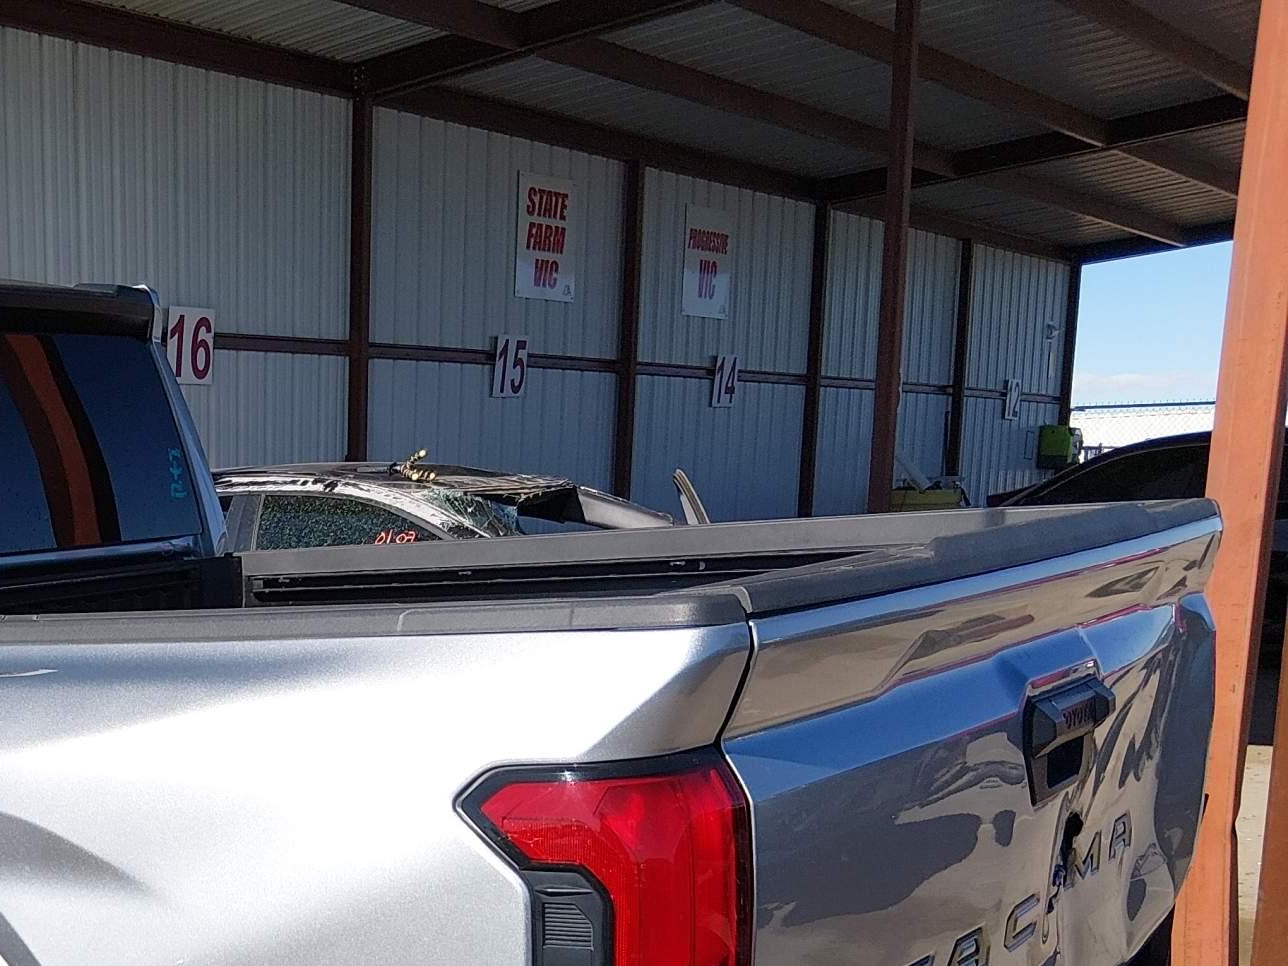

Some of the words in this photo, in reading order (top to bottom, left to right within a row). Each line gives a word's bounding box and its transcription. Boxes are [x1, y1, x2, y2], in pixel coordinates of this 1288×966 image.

[526, 186, 569, 221] STATE
[525, 221, 567, 255] FARM
[169, 314, 212, 380] 16
[498, 338, 527, 395] 15
[716, 356, 737, 404] 14
